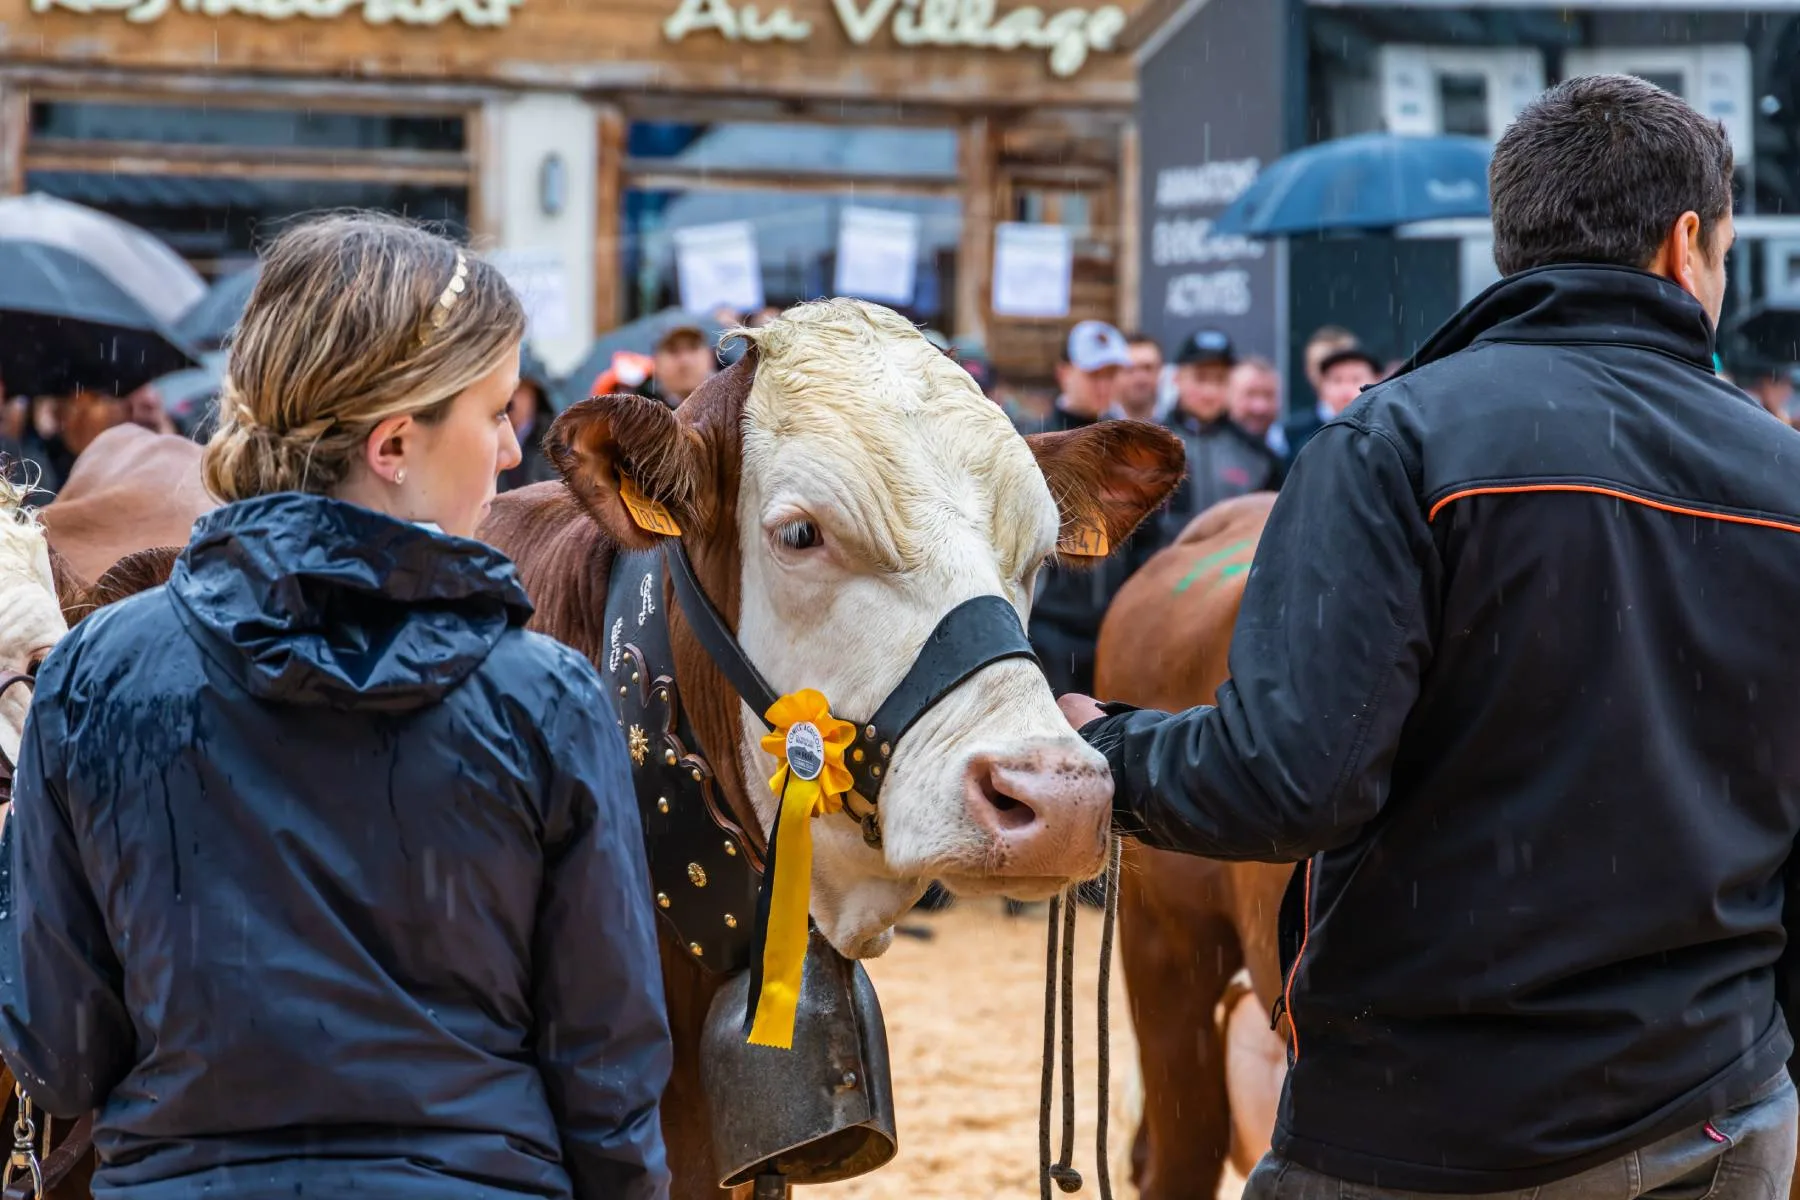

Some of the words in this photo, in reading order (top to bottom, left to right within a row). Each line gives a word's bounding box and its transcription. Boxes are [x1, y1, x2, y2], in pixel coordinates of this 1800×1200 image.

[663, 0, 811, 41] Au
[831, 0, 1127, 77] Village
[630, 504, 674, 534] 7047
